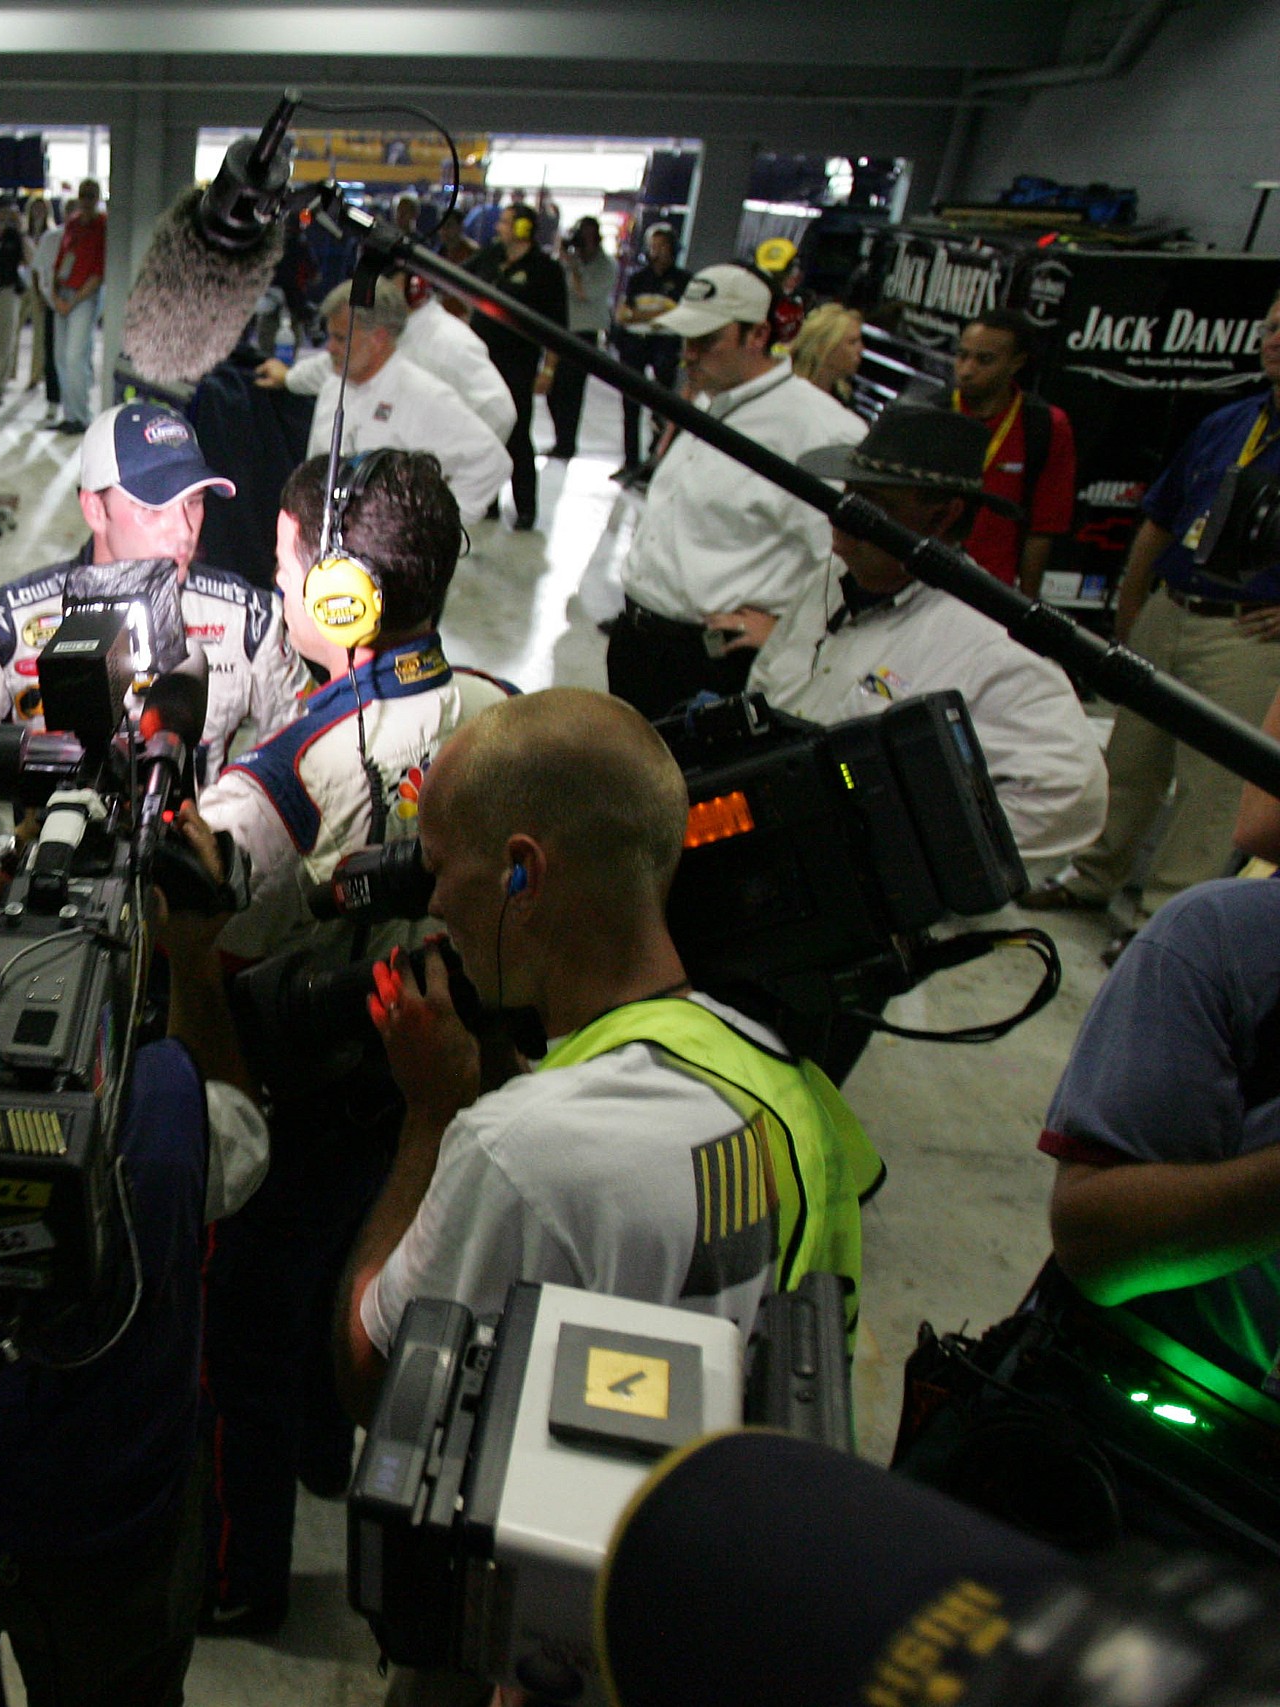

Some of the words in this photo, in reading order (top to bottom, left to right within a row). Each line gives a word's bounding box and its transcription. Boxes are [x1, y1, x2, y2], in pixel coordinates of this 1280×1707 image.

[883, 240, 926, 304] JACK
[1067, 305, 1160, 352] JACK
[1162, 308, 1266, 355] DANIE
